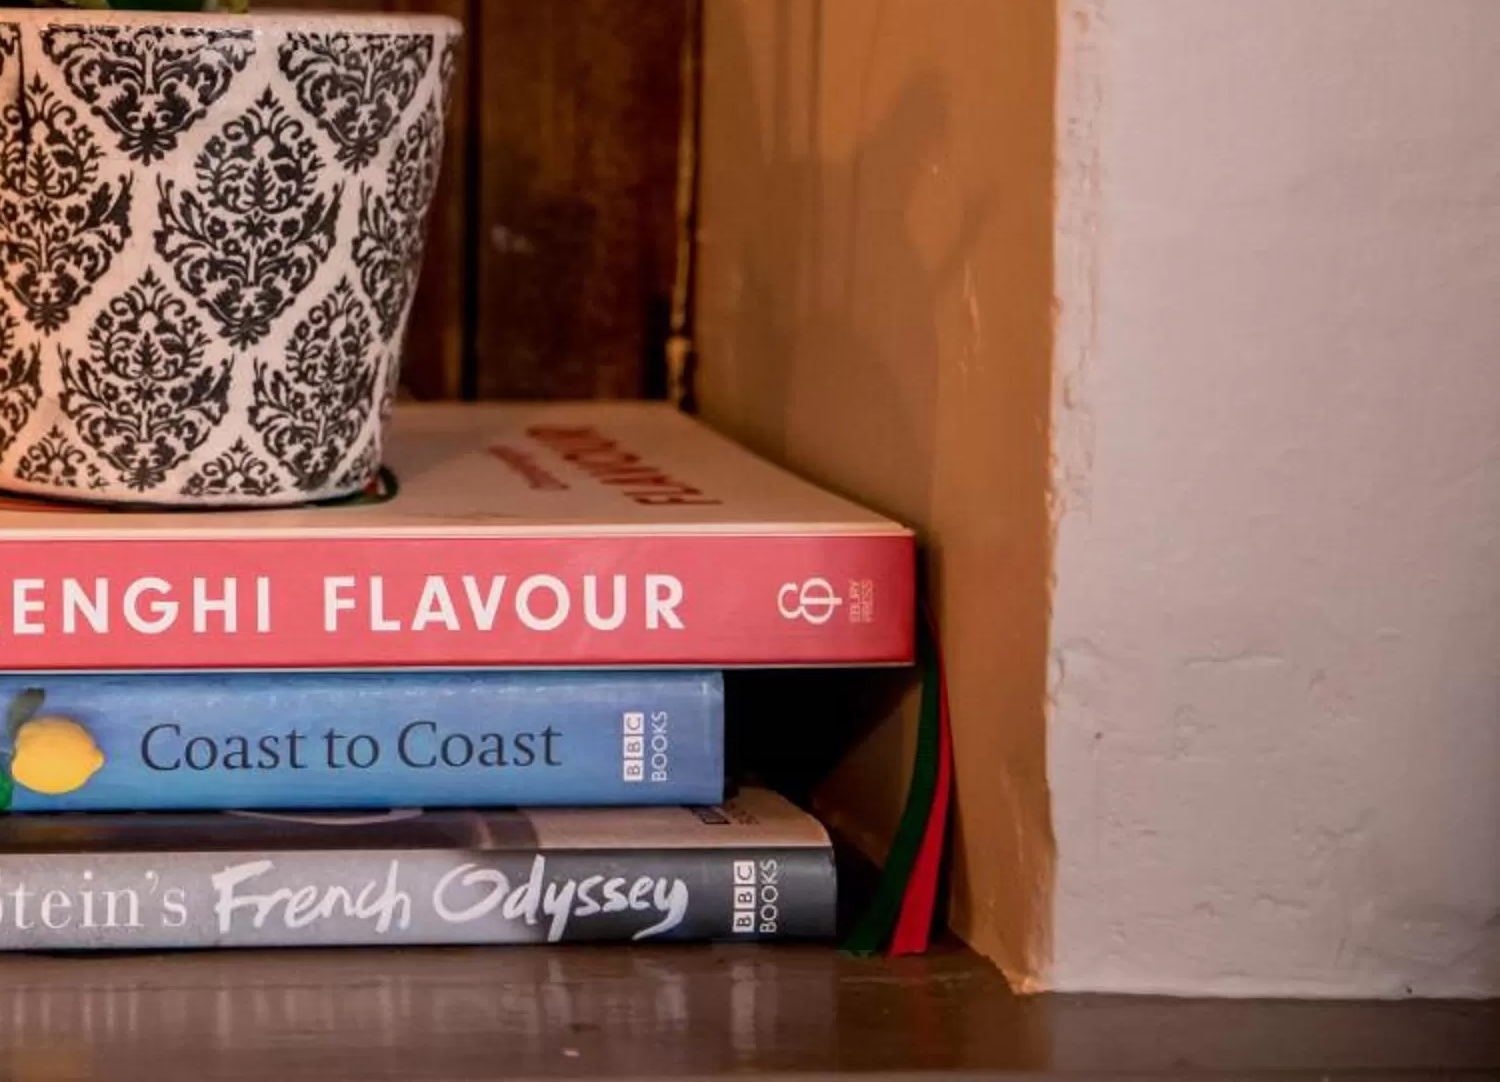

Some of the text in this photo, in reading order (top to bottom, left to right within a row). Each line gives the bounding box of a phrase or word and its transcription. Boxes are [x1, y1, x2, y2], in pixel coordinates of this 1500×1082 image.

[323, 573, 685, 633] FLAVOUR
[140, 720, 563, 772] Coast to Coast
[623, 712, 644, 782] BBC
[651, 711, 668, 782] BOOKS
[211, 860, 413, 933] French
[433, 854, 690, 941] Odyssey
[733, 860, 755, 933] BBC
[759, 859, 778, 933] BOOKS
